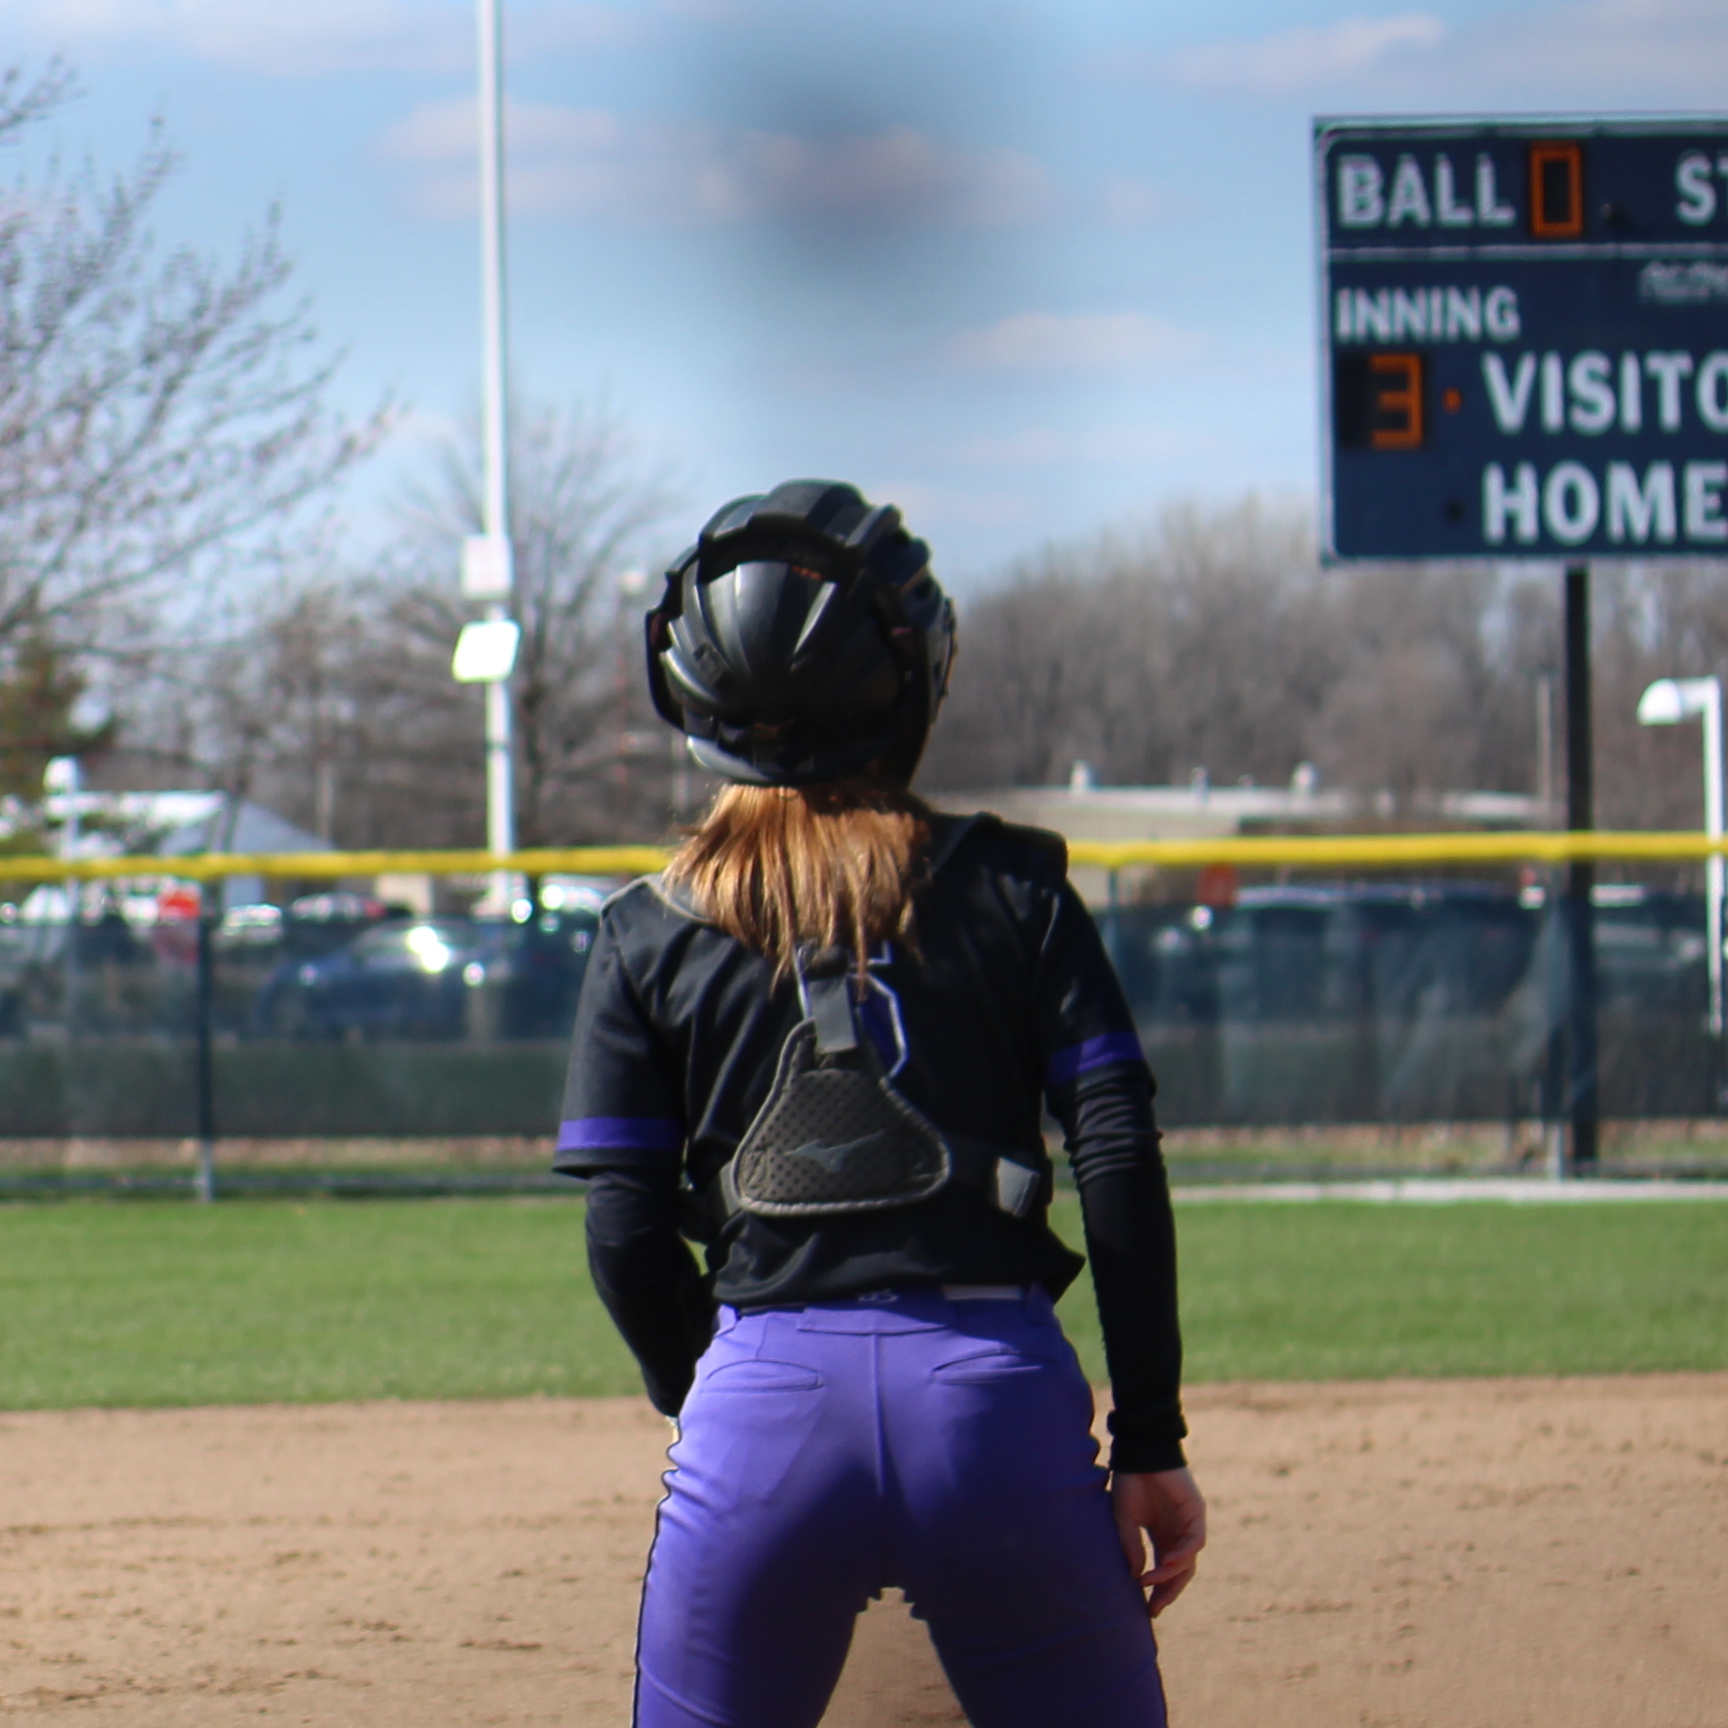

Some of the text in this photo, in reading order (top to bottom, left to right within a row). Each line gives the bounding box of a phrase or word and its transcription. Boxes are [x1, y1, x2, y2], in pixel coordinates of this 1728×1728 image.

[1338, 141, 1728, 238] BALL 0 S
[1337, 285, 1522, 343] INNING
[1369, 353, 1425, 452] 3
[1481, 460, 1728, 545] HOME
